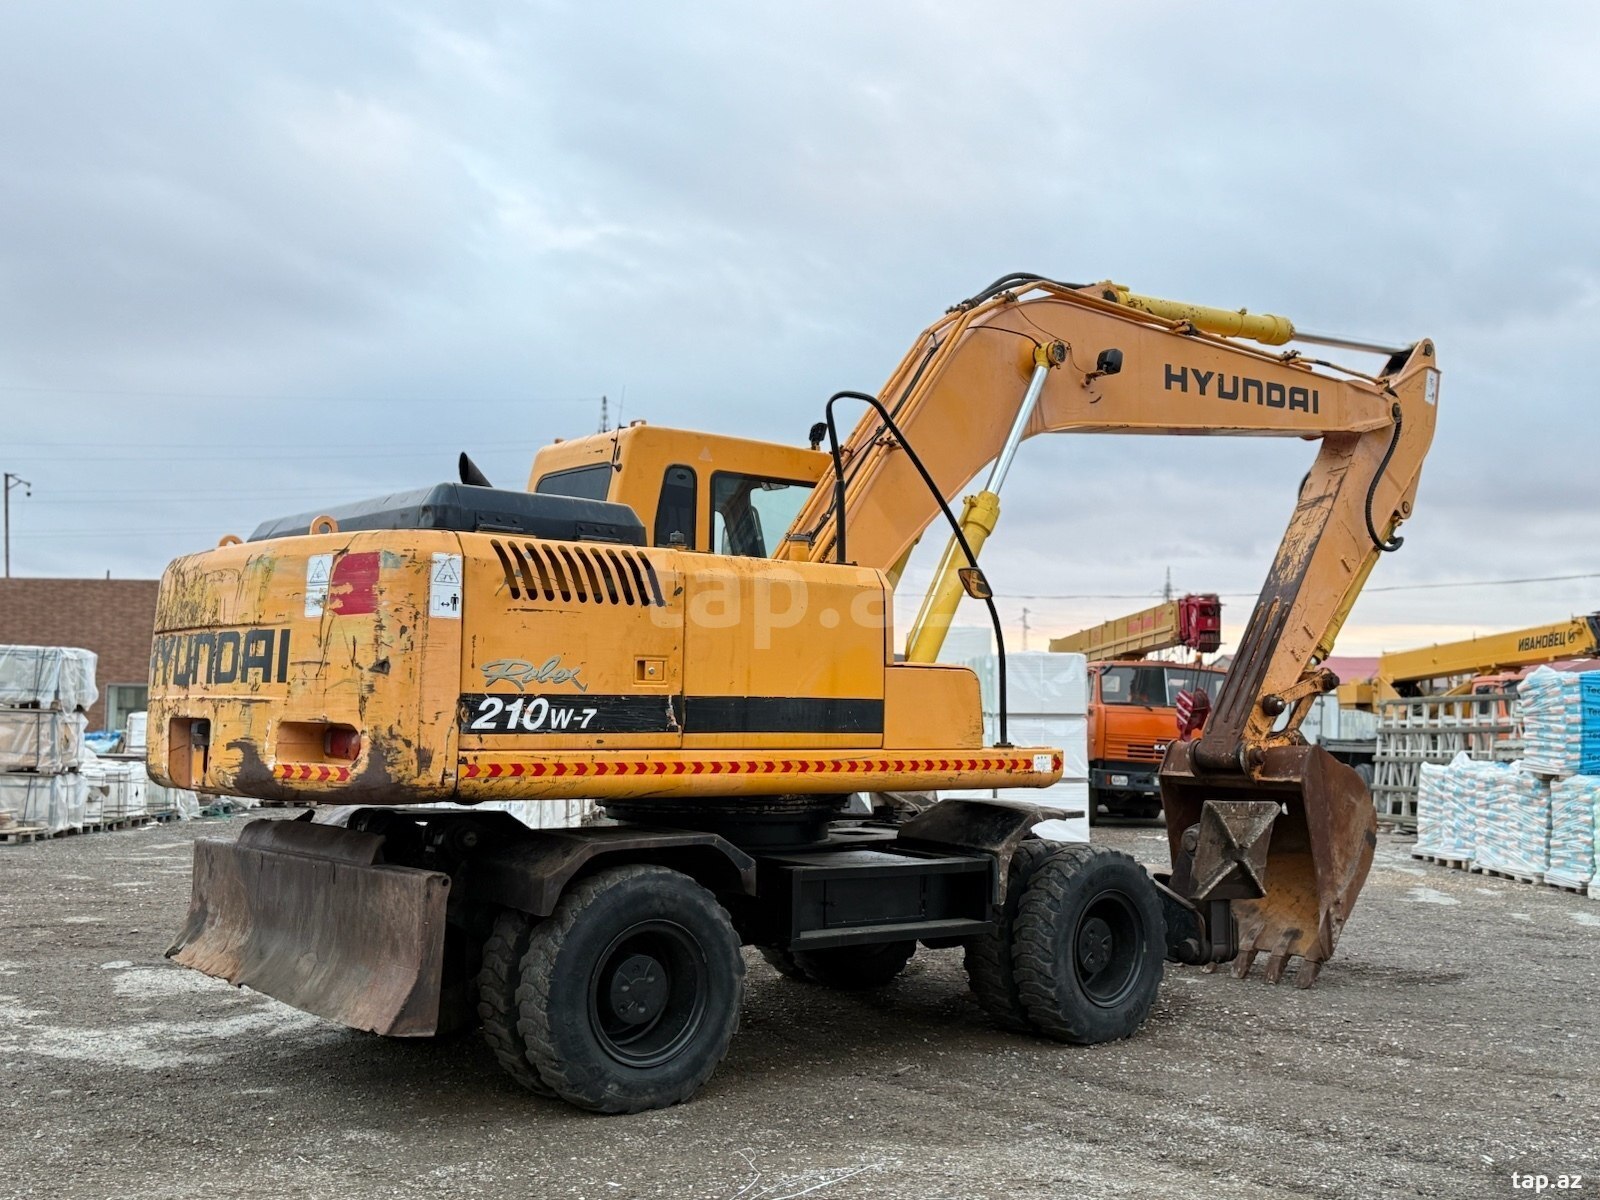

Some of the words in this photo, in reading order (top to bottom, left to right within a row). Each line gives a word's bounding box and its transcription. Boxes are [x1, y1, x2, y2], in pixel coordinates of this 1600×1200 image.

[1164, 363, 1319, 414] HYUNDAI
[1518, 631, 1566, 652] ИВАНОВЕЦ
[480, 655, 588, 692] Robex
